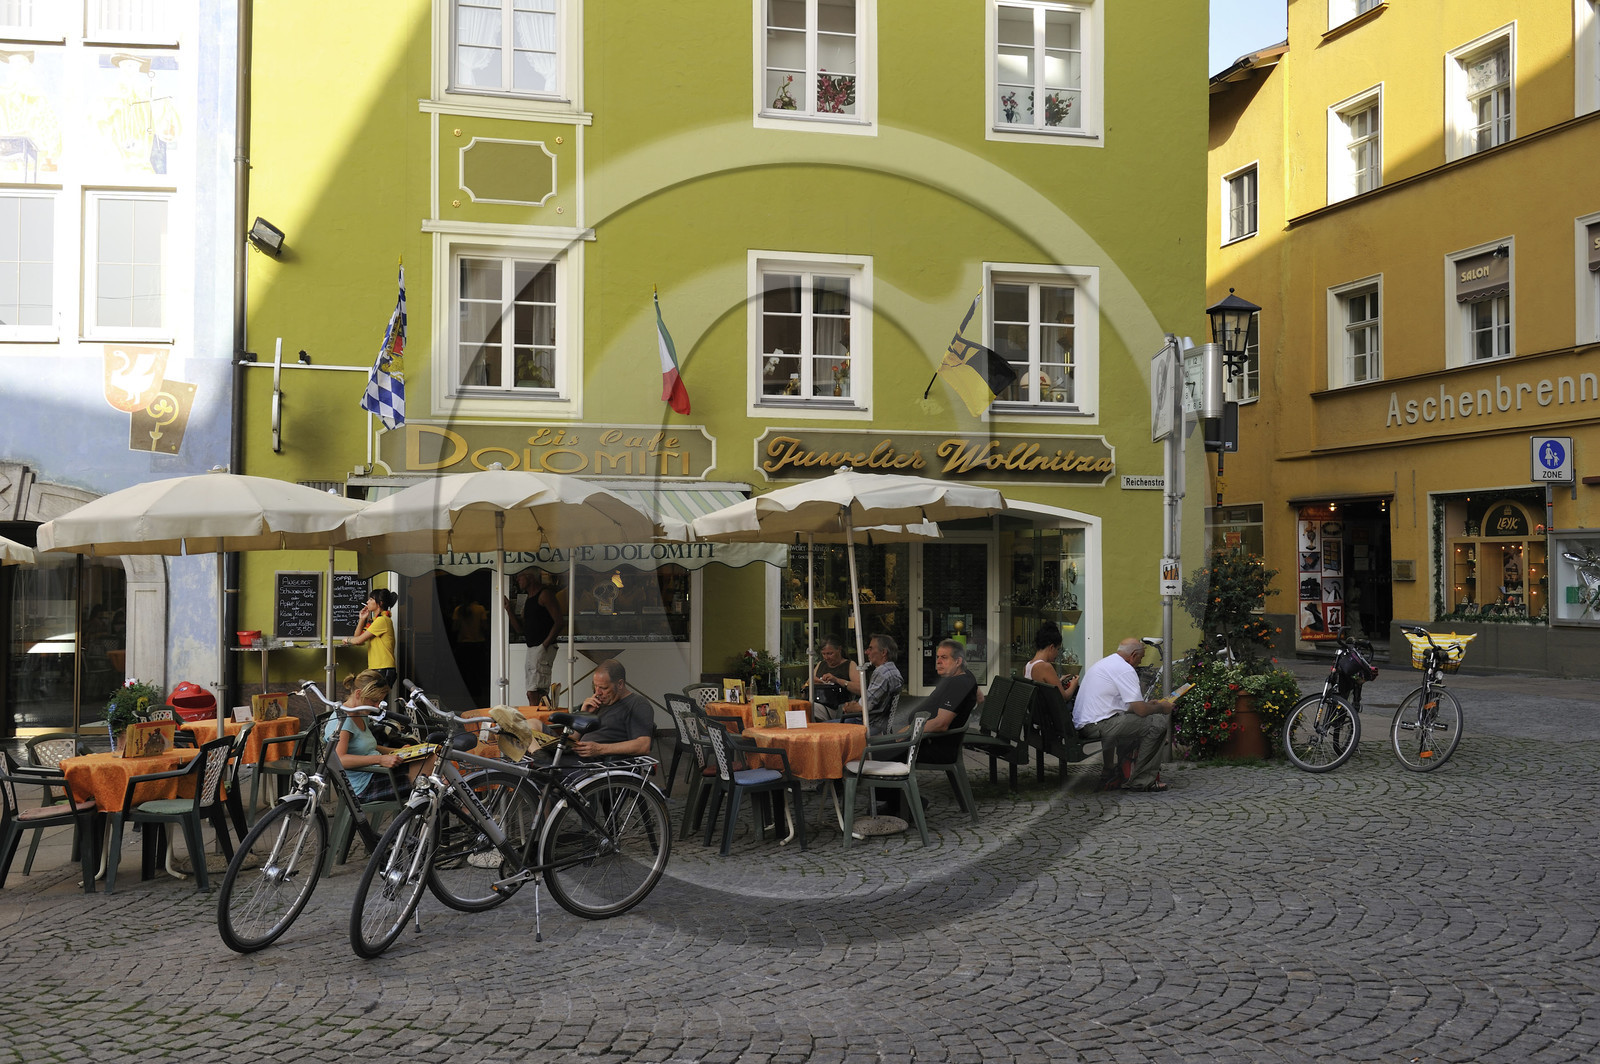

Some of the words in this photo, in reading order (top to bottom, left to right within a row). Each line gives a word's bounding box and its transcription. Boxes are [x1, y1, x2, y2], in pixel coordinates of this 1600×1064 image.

[1461, 265, 1490, 283] SALON
[1386, 372, 1599, 427] Aschenbrenn
[528, 429, 580, 447] Eis
[599, 429, 681, 450] Cafe
[763, 436, 926, 475] Juwelier
[936, 438, 1116, 475] Wollnitza
[1542, 470, 1562, 479] ZONE
[1496, 517, 1518, 530] LEYK
[603, 543, 716, 561] DOLOMITI
[1164, 564, 1179, 580] VIA
[458, 780, 491, 820] RALEIGH
